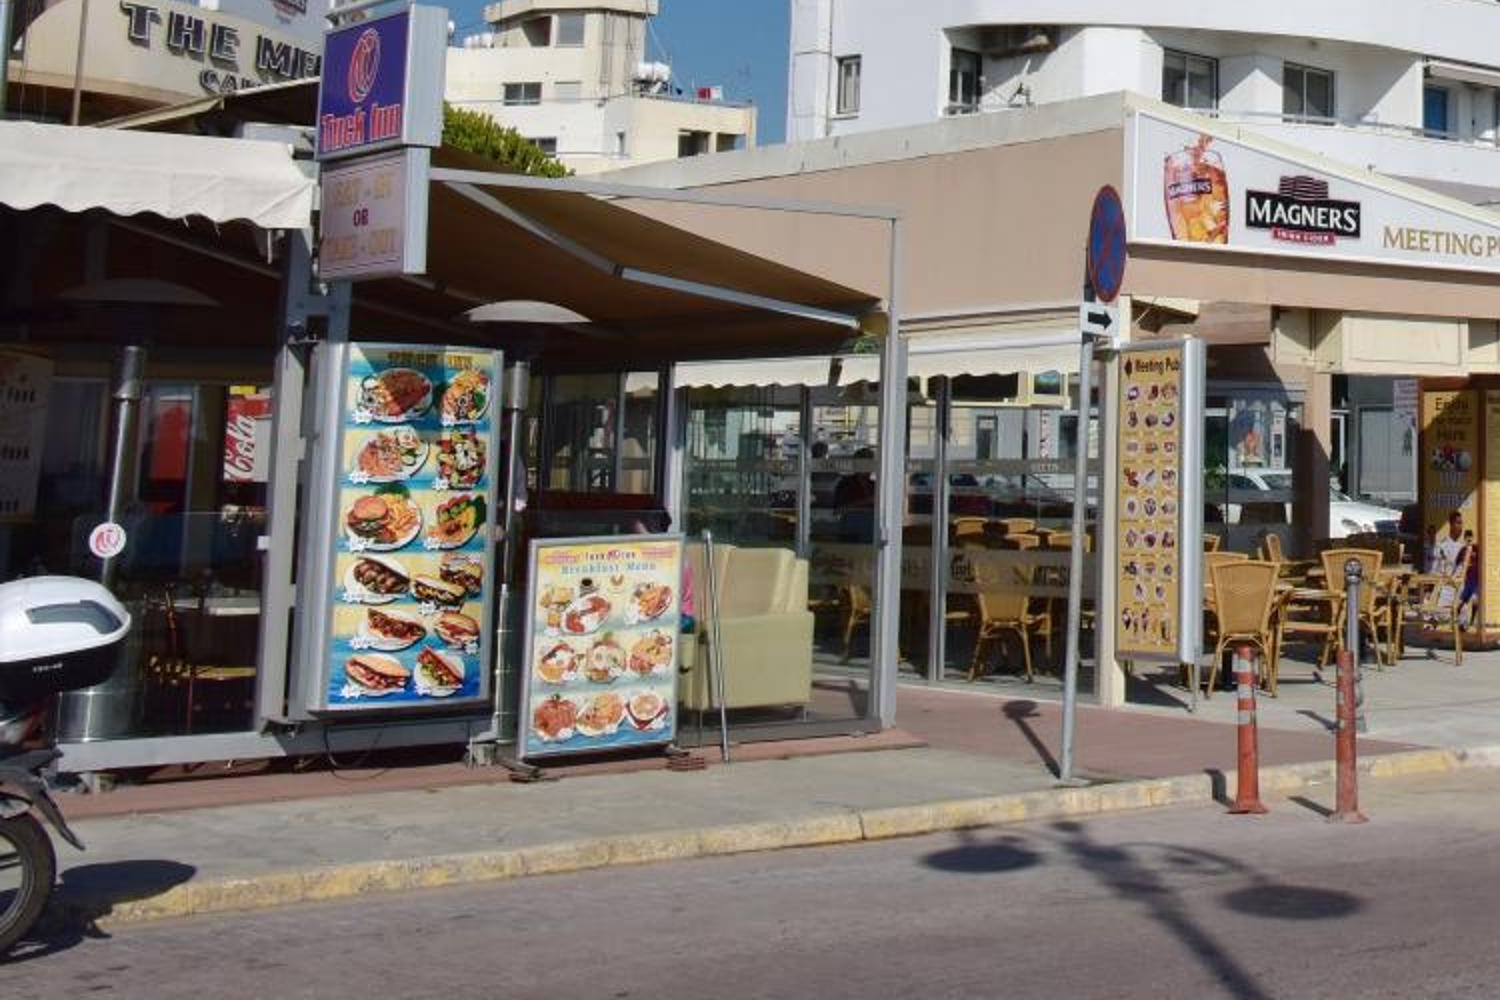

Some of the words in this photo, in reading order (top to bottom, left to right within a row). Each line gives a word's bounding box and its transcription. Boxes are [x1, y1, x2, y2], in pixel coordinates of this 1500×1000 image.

[120, 0, 241, 64] THE
[1249, 196, 1358, 233] MAGNERS
[1383, 226, 1482, 257] MEETING
